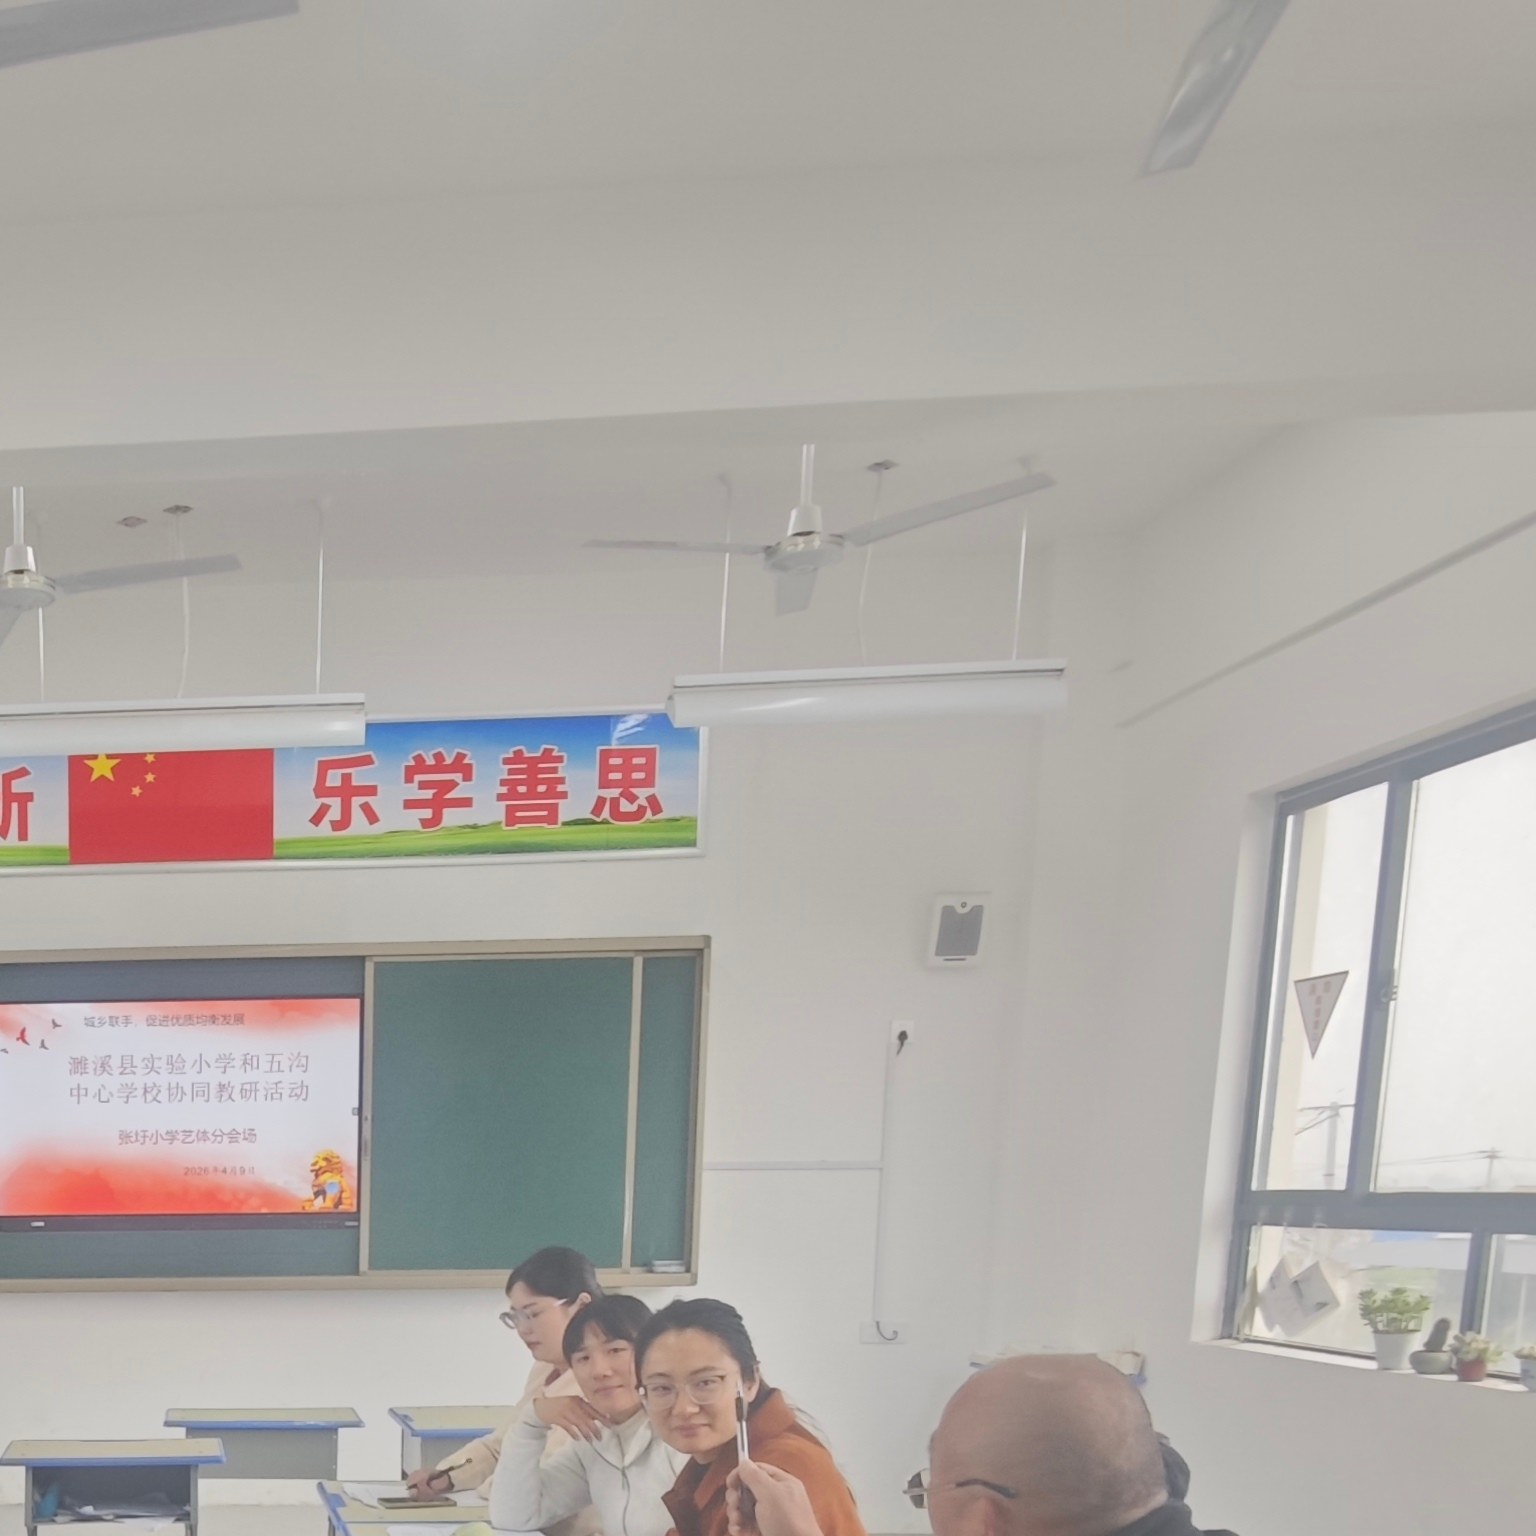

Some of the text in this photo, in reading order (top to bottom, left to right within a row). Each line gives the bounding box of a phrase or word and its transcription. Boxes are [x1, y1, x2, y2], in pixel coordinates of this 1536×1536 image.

[308, 744, 665, 832] 乐学善思
[67, 1051, 310, 1077] 濉溪县实验小学和五沟
[68, 1079, 310, 1105] 中心学校协同教研活动
[118, 1128, 257, 1146] 张圩小学艺体分会场
